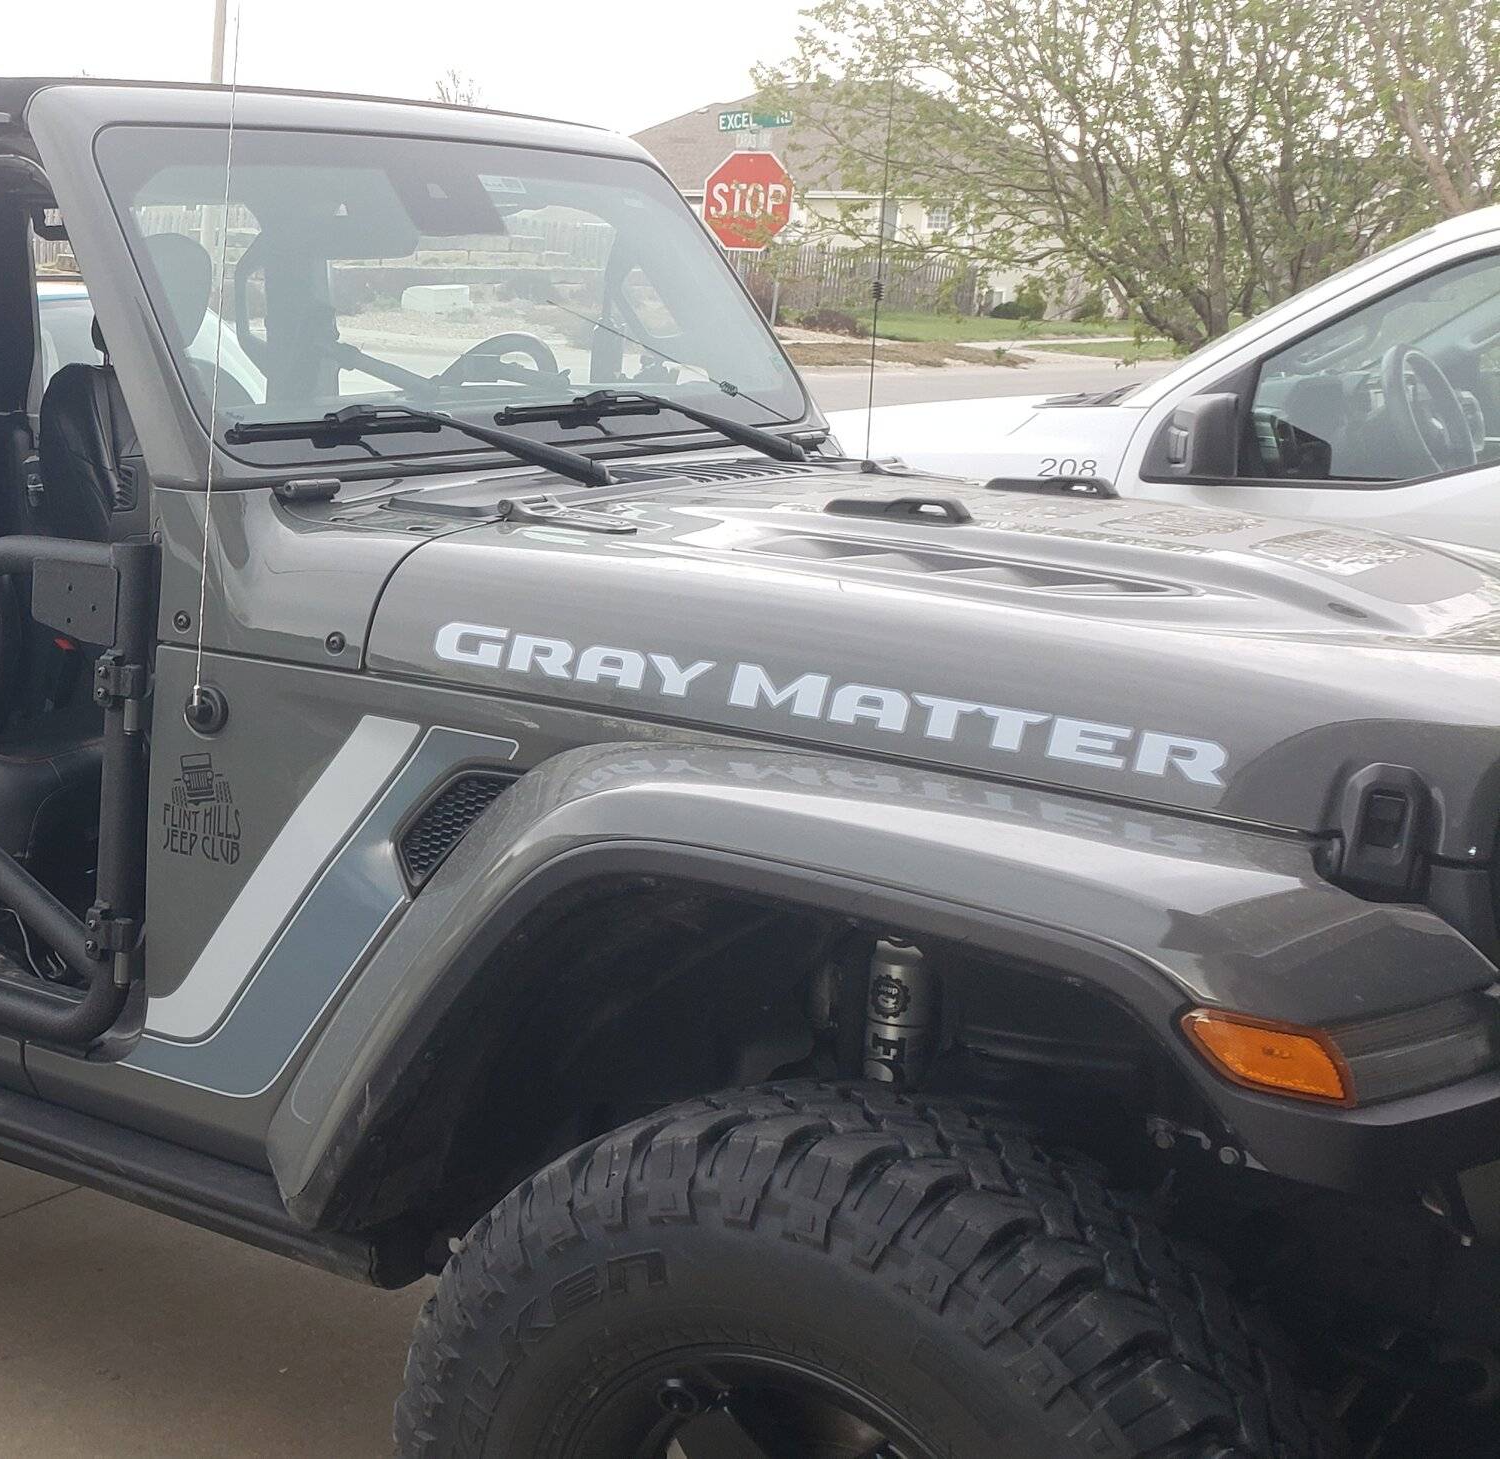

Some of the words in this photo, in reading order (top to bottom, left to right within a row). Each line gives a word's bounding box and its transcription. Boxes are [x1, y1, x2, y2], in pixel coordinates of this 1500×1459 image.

[719, 112, 757, 130] EXCEL
[710, 182, 787, 218] STOP
[1037, 458, 1097, 477] 208
[434, 621, 714, 696] GRAY
[729, 663, 1228, 787] MATTER
[163, 803, 200, 832] FLINT
[203, 804, 240, 840] HILLS
[163, 828, 198, 856] JEEP
[202, 836, 240, 865] CLUB
